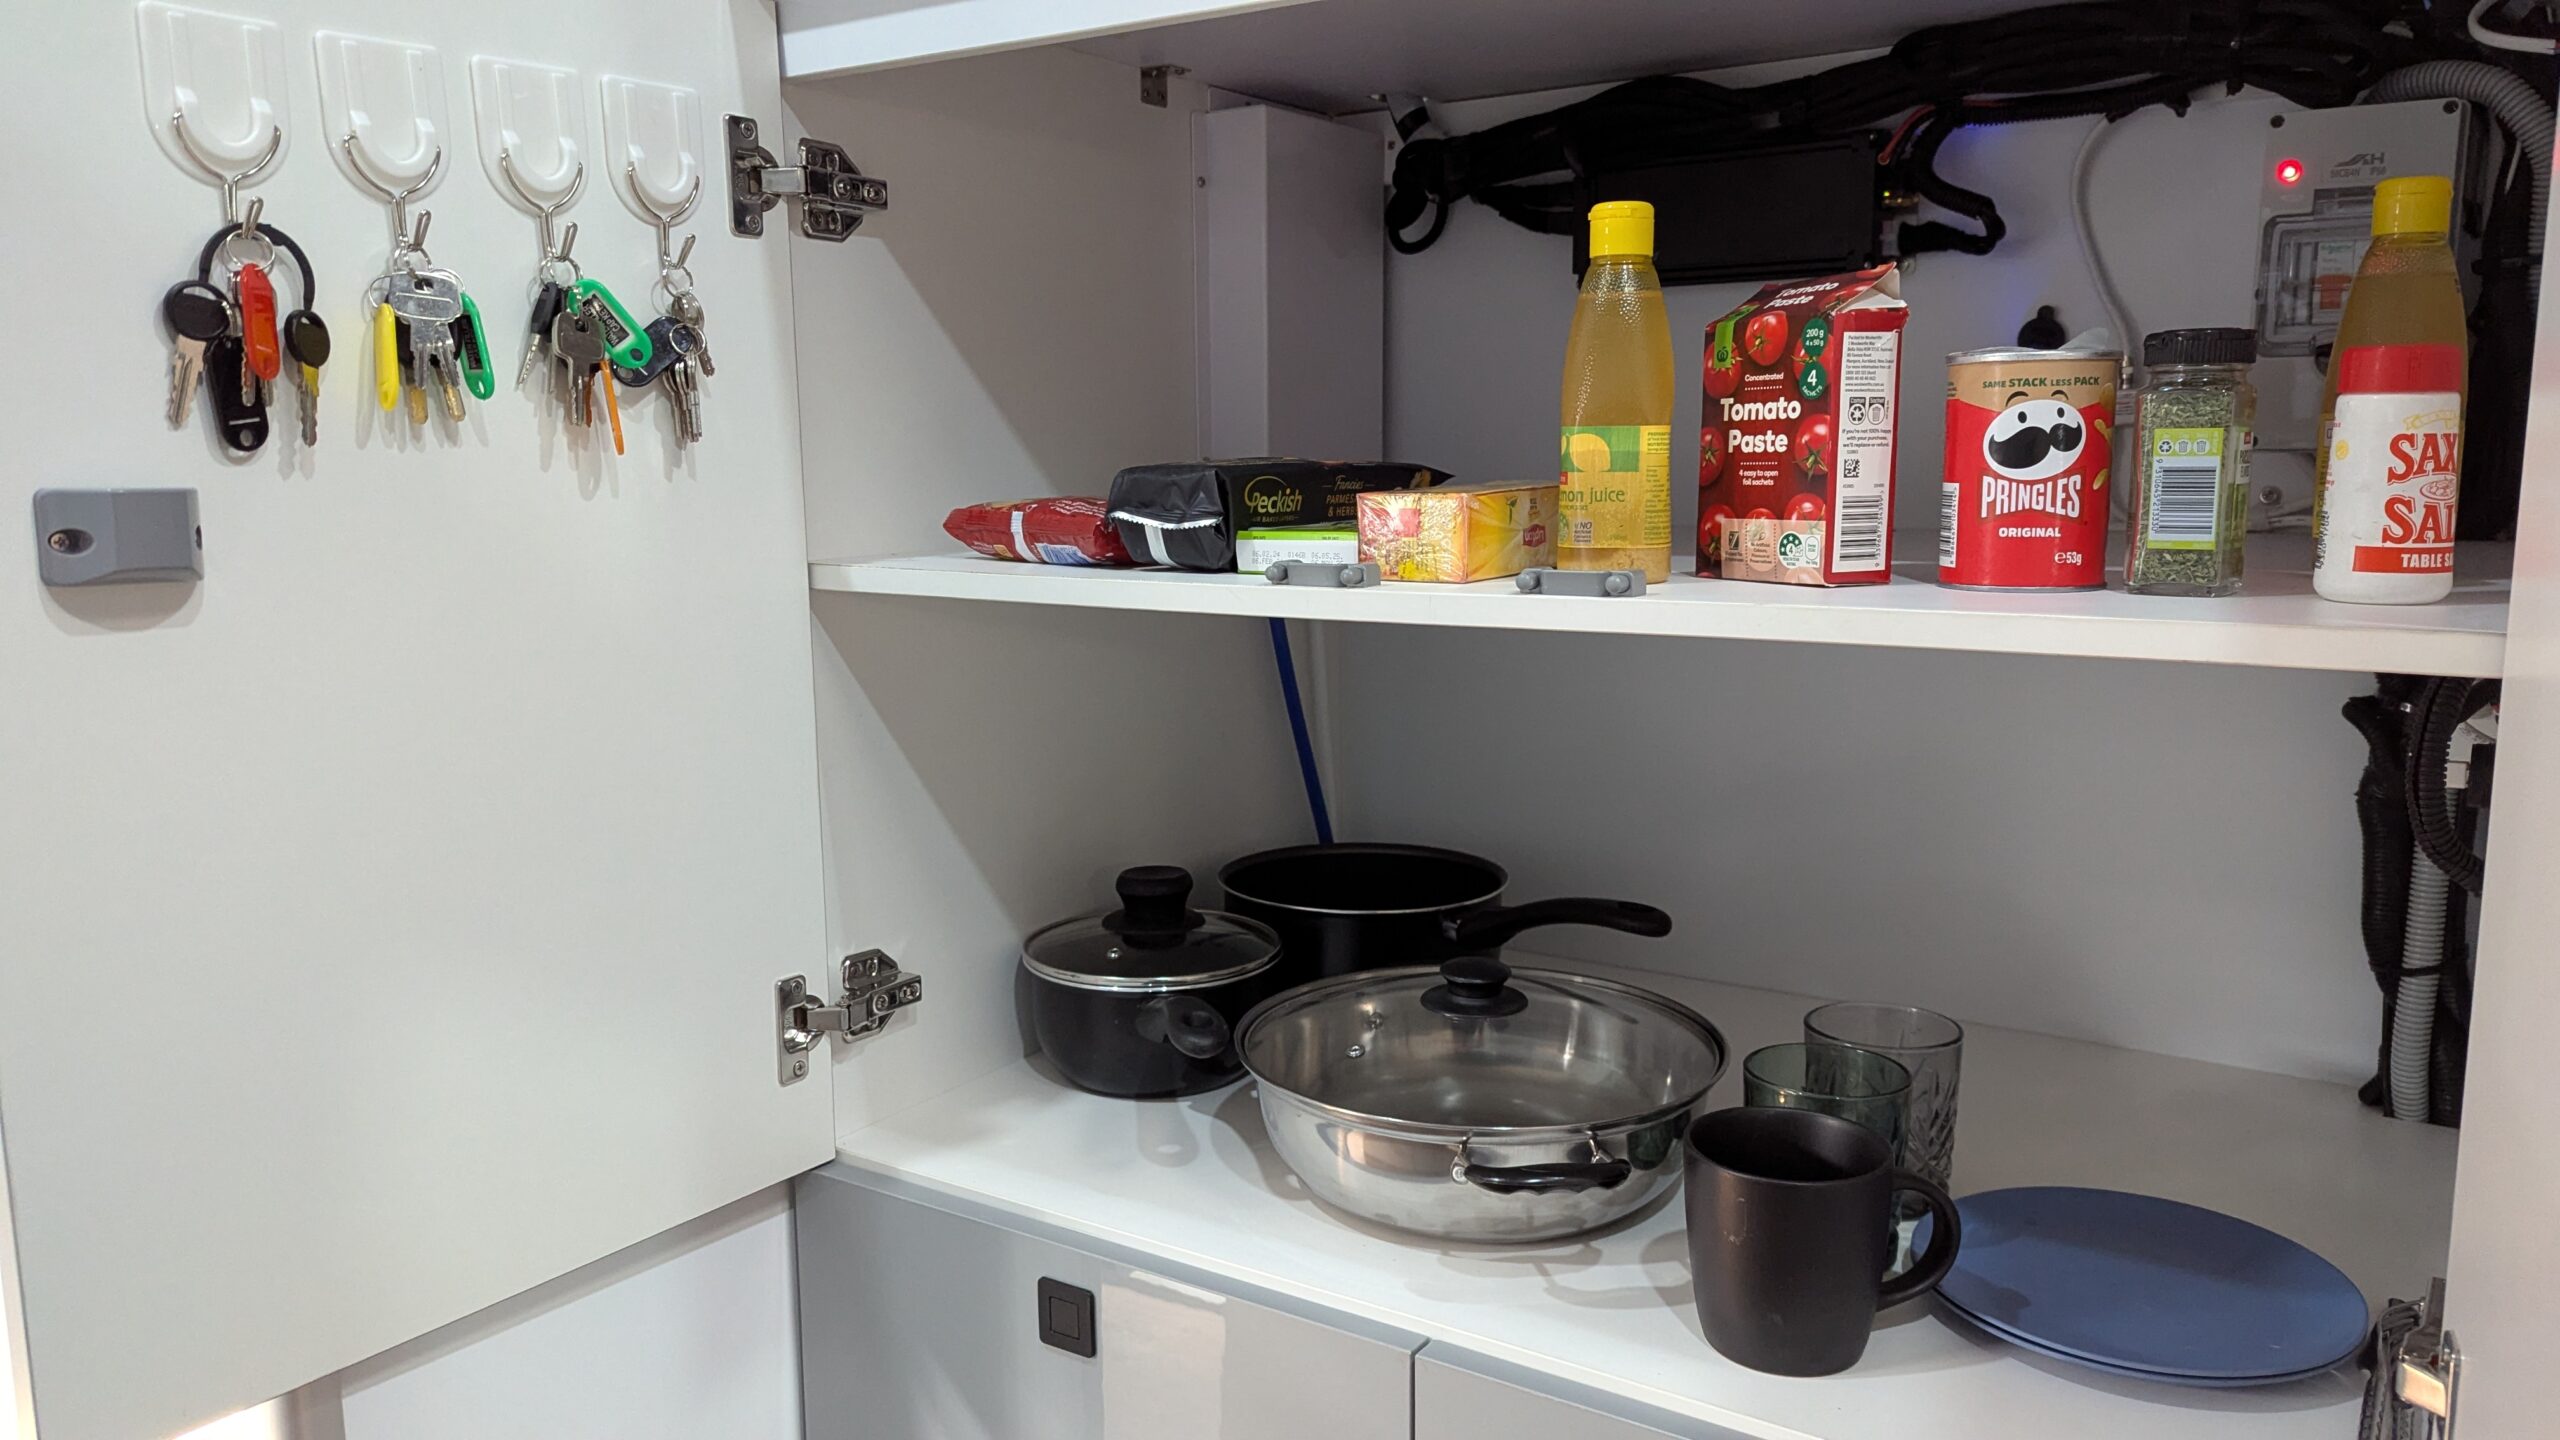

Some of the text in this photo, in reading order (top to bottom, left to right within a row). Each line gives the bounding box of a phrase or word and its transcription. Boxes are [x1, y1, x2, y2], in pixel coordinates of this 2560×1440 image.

[1776, 282, 1839, 298] Tomato
[1764, 294, 1814, 309] Paste
[1806, 329, 1818, 338] 200
[1744, 372, 1784, 382] Concentrated
[1807, 370, 1817, 386] 4
[1982, 376, 2100, 389] SAME STACK LESS PACK
[1802, 385, 1823, 397] SACHETS
[1720, 397, 1801, 421] Tomato
[1728, 430, 1788, 453] Paste
[2387, 433, 2458, 483] SAX
[1764, 470, 1778, 478] open
[2154, 468, 2163, 499] 310645
[1245, 485, 1302, 513] Peckish
[1326, 494, 1355, 504] PARMES
[1560, 488, 1625, 504] mon juice
[1980, 474, 2082, 518] PRINGLES
[1336, 506, 1356, 516] HERB
[2151, 502, 2160, 532] 213330
[1998, 527, 2061, 538] ORIGINAL
[2401, 554, 2442, 568] TABLE
